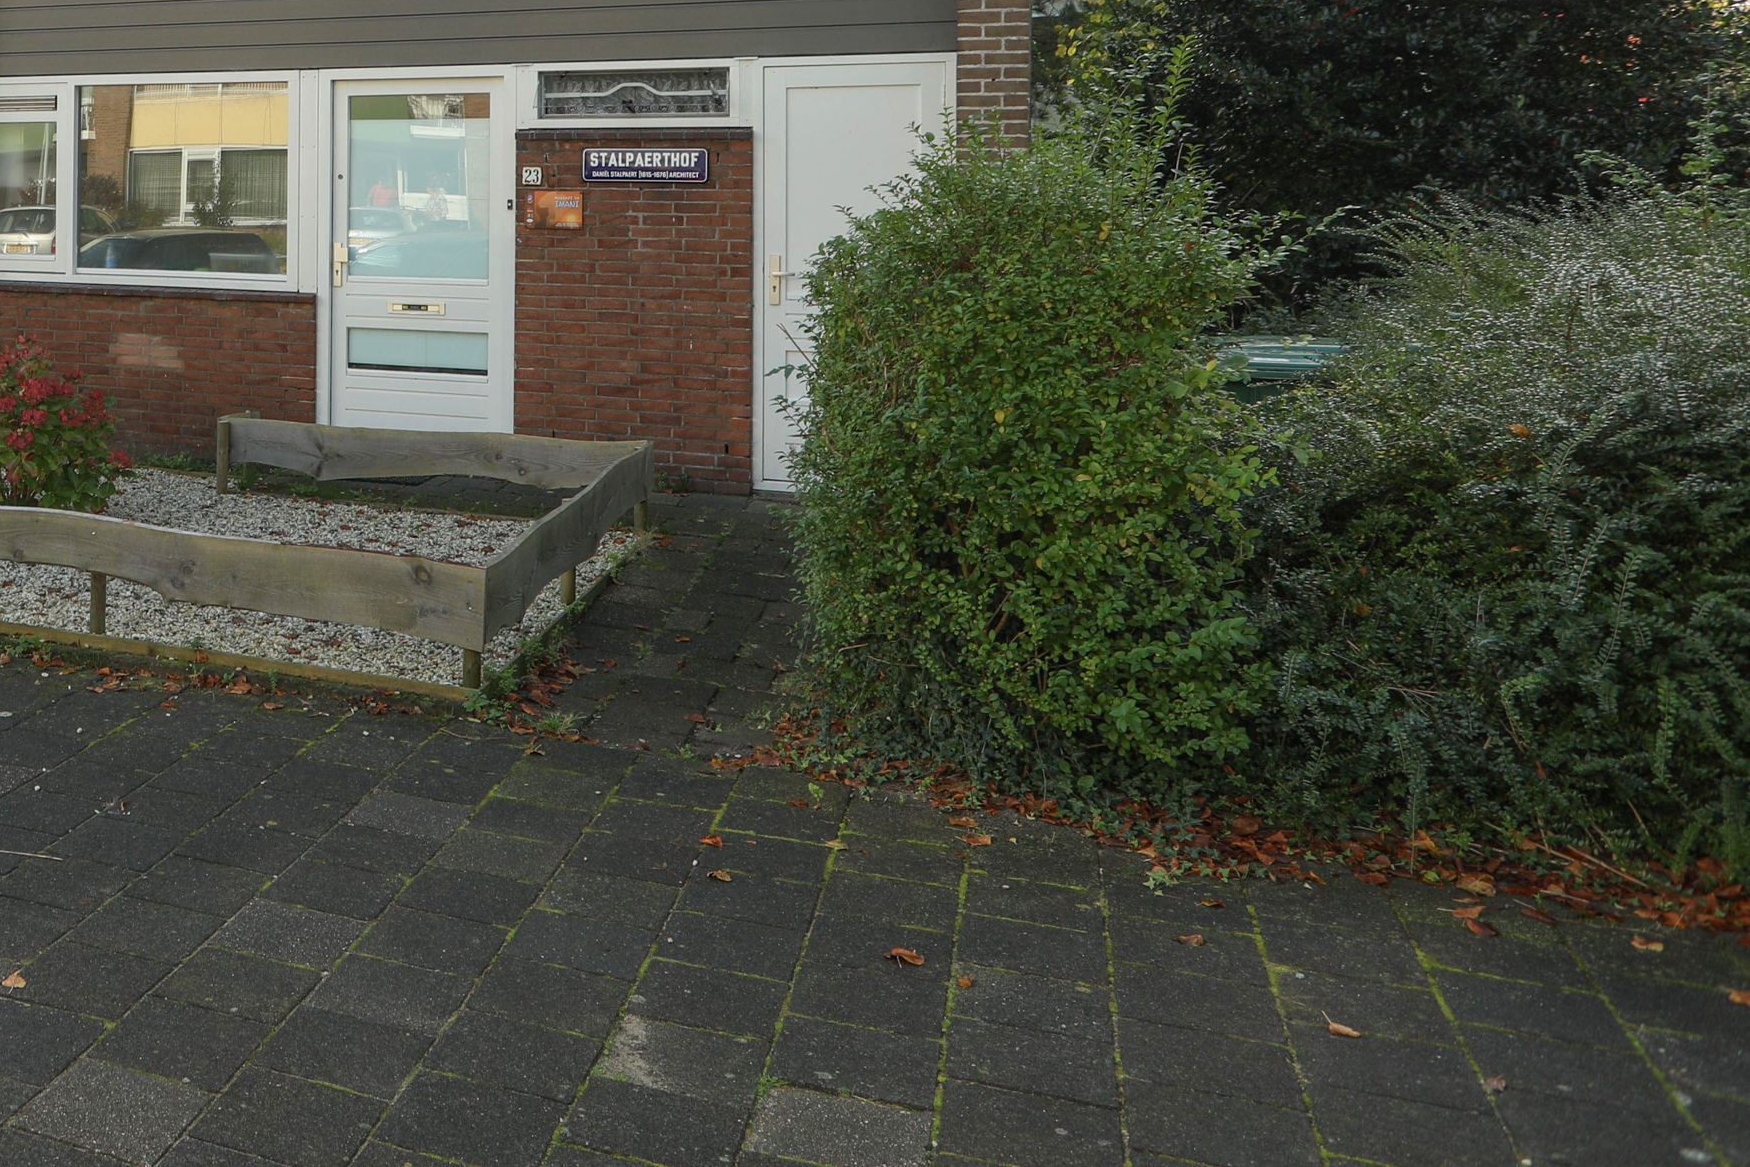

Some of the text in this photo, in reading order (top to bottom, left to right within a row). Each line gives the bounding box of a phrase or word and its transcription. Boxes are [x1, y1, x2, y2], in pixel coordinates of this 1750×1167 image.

[590, 152, 699, 167] STALPAERTHOF
[524, 169, 539, 183] 23
[592, 170, 609, 178] DANIËL
[669, 171, 699, 179] ARCHITECT
[555, 200, 579, 208] IMANI
